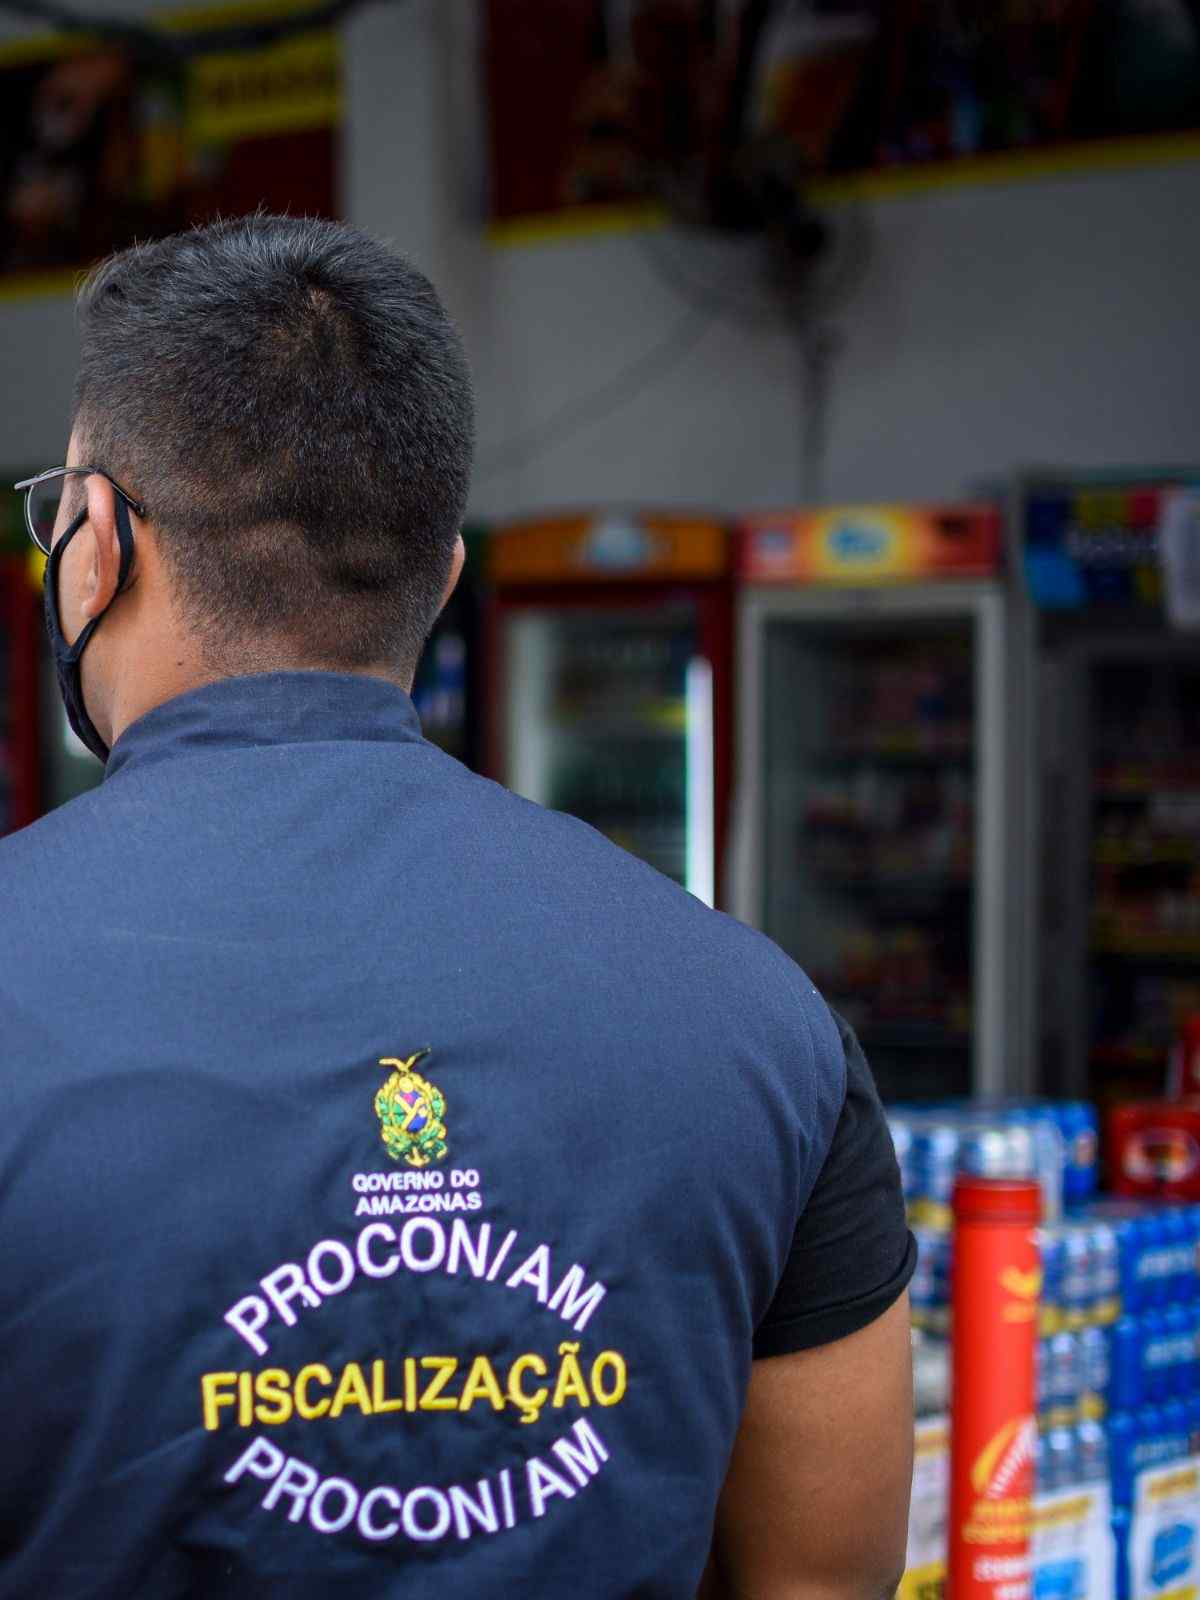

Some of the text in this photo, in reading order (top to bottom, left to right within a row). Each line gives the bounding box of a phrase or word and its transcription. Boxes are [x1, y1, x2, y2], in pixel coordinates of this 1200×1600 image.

[353, 1170, 480, 1193] GOVERNO DO
[355, 1192, 482, 1216] AMAZONAS
[224, 1216, 607, 1357] PROCON/AM
[202, 1341, 627, 1431] FISCALIZAÇÃO
[224, 1417, 610, 1542] PROCON/AM
